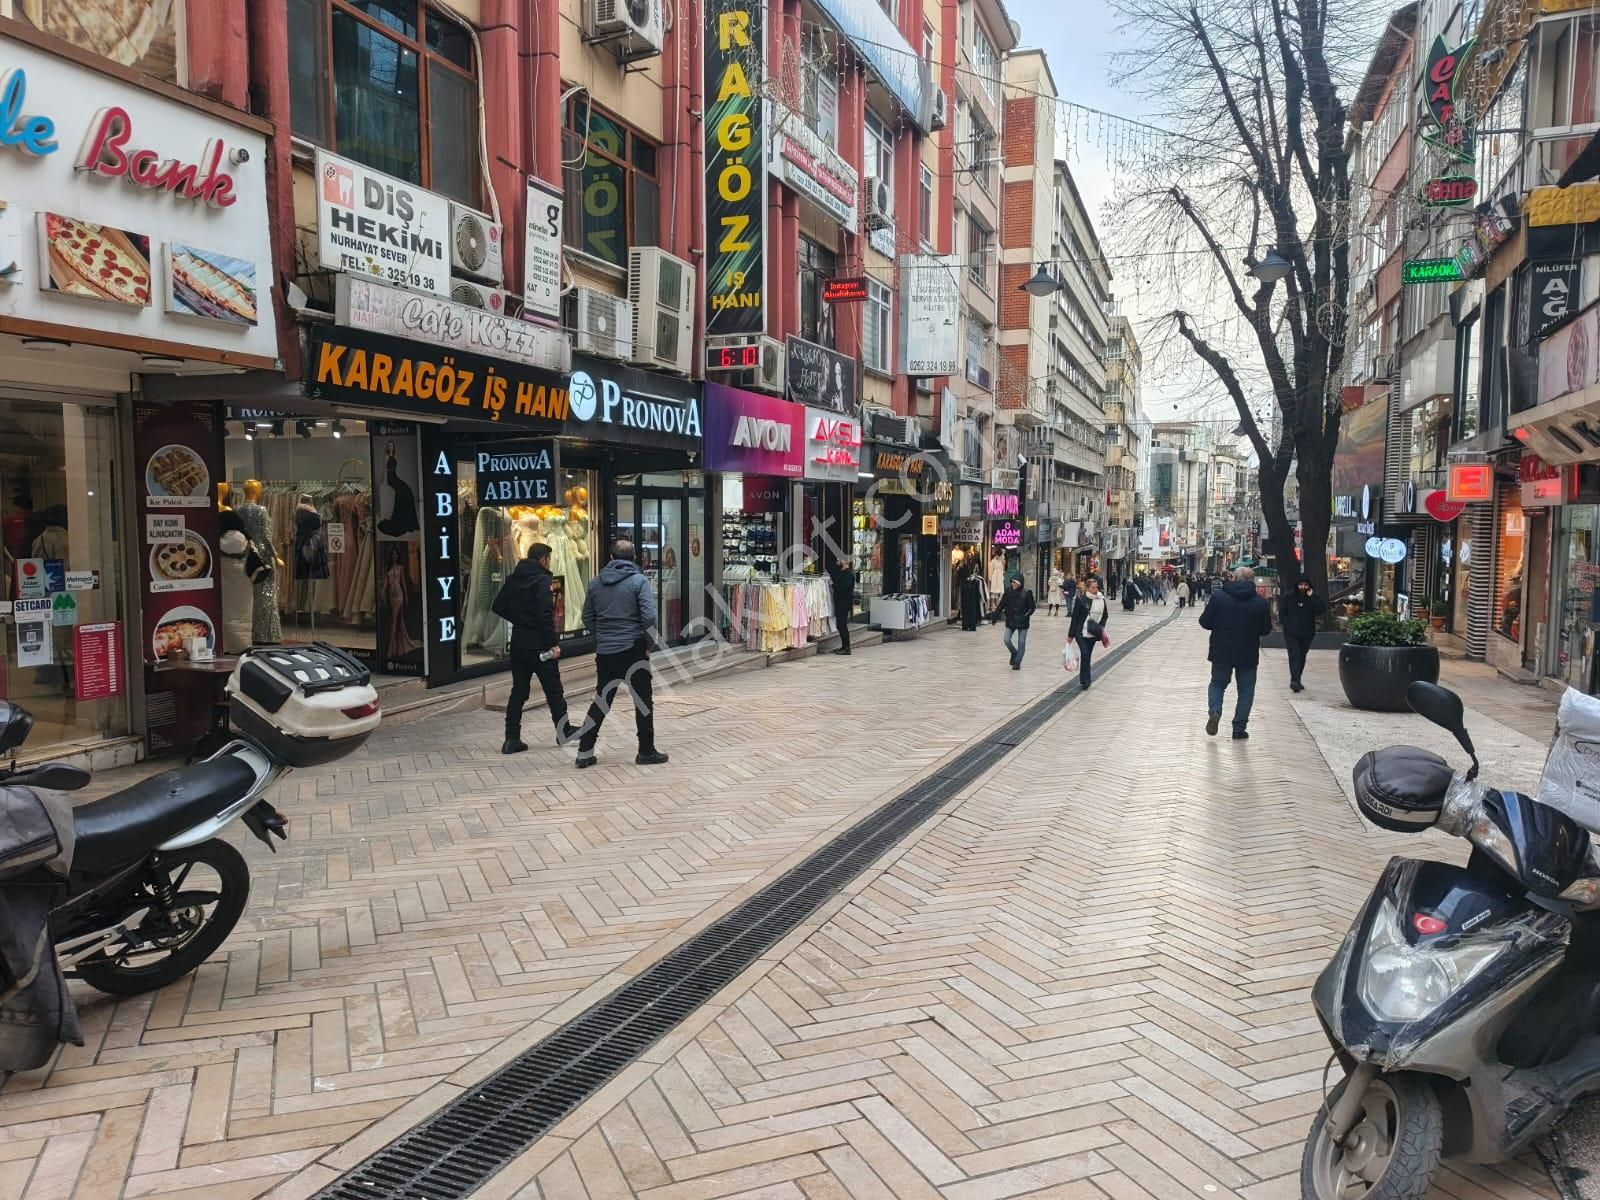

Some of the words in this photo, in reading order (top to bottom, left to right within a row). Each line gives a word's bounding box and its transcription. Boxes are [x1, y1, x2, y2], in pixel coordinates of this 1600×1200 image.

[78, 107, 237, 208] Bank
[330, 232, 379, 256] NURHAYAT
[380, 246, 408, 265] SEVER
[387, 266, 406, 282] 325
[408, 271, 421, 287] 19
[423, 274, 435, 290] 38
[527, 282, 538, 293] KAT
[712, 292, 760, 310] HANI
[402, 297, 462, 343] Cafe
[909, 360, 924, 372] 0262
[926, 361, 938, 372] 324
[317, 341, 474, 406] KARAGÖZ
[482, 366, 506, 421] İŞ
[515, 380, 570, 421] HANI
[733, 416, 791, 452] AVON
[811, 417, 863, 448] AKSU
[478, 449, 551, 473] PRONOVA
[484, 476, 548, 501] ABİYE
[750, 490, 780, 499] AVON
[994, 536, 1020, 544] MODA
[995, 529, 1020, 537] ADAM
[433, 450, 456, 642] ABİYE
[15, 599, 52, 612] SETCARD
